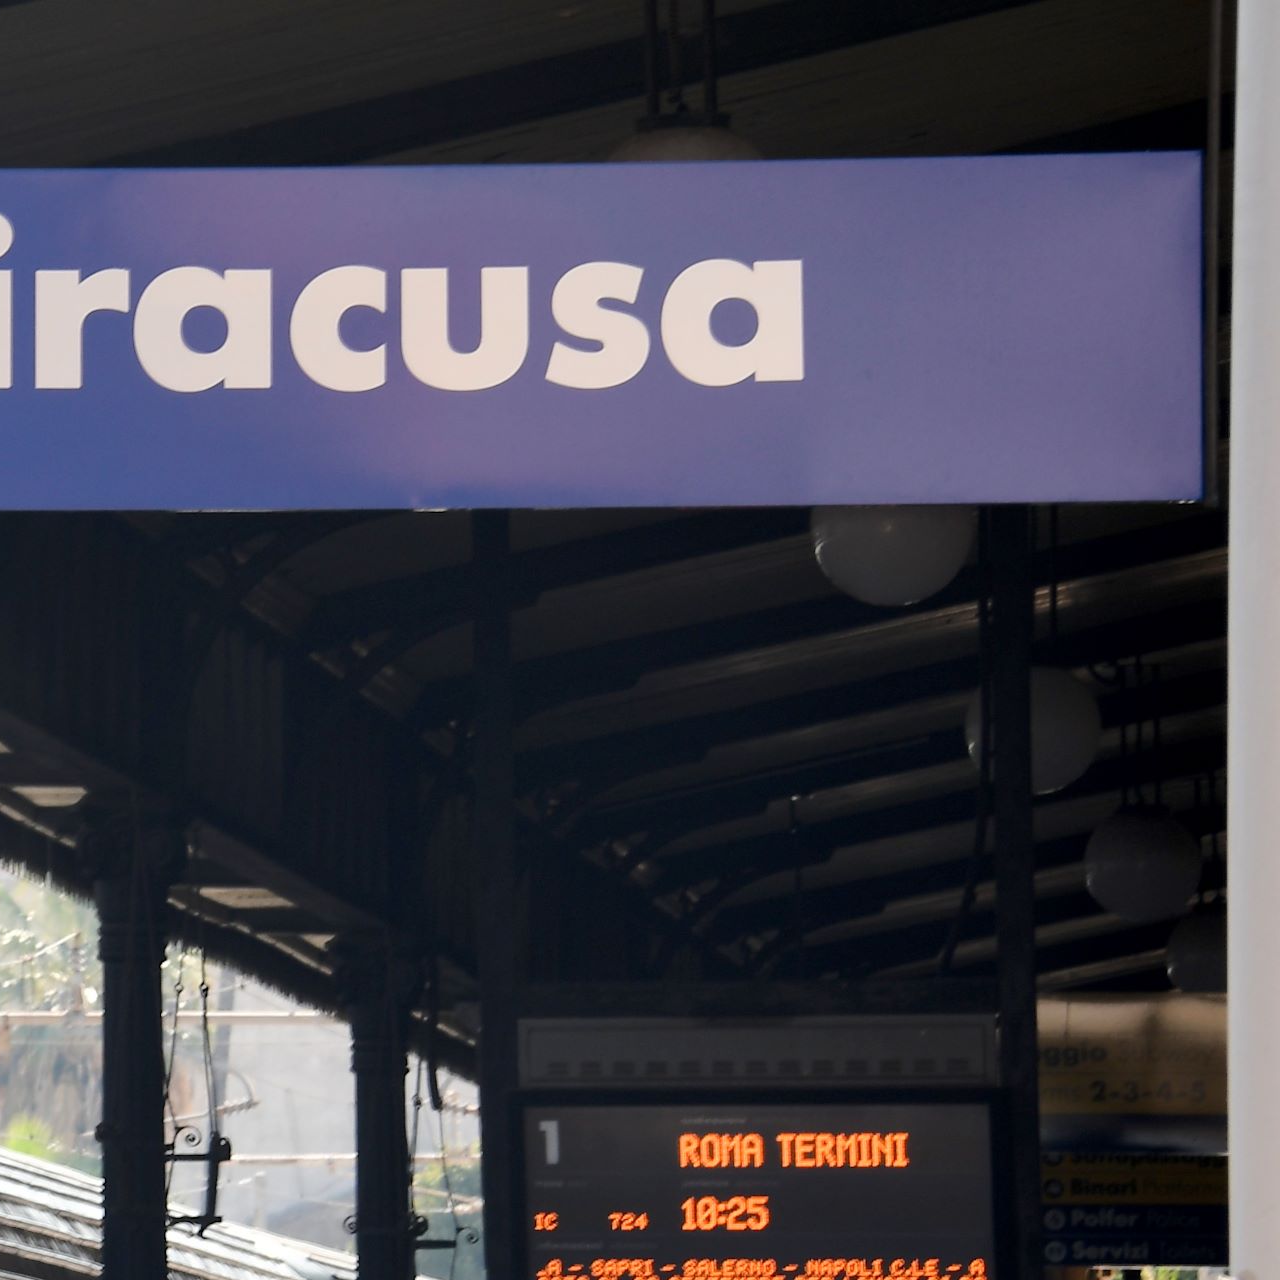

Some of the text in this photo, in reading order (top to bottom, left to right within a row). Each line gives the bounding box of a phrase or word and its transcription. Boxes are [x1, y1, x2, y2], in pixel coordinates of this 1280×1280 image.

[538, 1120, 910, 1168] 1 ROMA TERMINI
[1071, 1178, 1137, 1195] Binari
[534, 1195, 771, 1231] IC 724 10:25
[1070, 1208, 1139, 1227] Polfer
[1071, 1240, 1149, 1260] Servizi
[590, 1258, 655, 1277] SAPRI
[682, 1258, 777, 1277] SALERNO
[804, 1258, 883, 1277] NAPOLI
[968, 1258, 985, 1277] A
